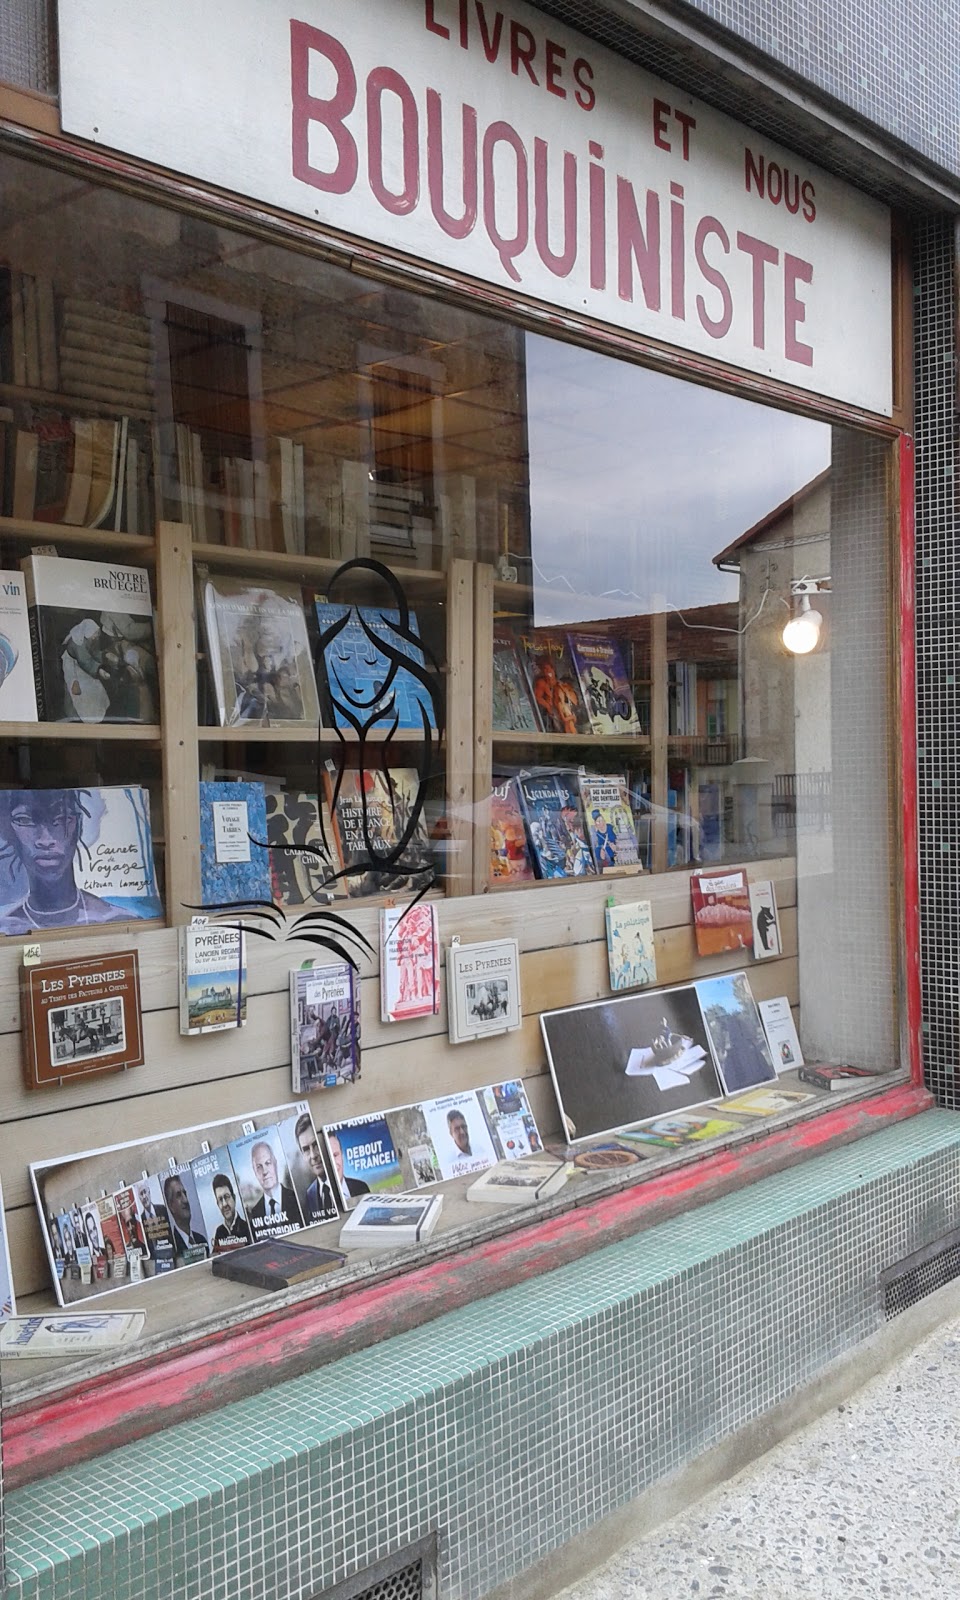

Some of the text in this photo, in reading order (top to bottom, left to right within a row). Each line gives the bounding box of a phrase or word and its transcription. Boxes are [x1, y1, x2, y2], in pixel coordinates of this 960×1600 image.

[425, 0, 816, 223] LIVRES ET NOUS
[109, 570, 147, 583] NOTRE
[2, 581, 21, 596] vin
[94, 578, 148, 594] BRUEGEL
[343, 819, 356, 830] DE
[345, 831, 358, 841] EN
[96, 844, 138, 856] Carnets
[346, 839, 392, 852] TABLAUX
[89, 859, 146, 879] Voyage
[459, 963, 474, 974] LES
[475, 956, 512, 972] PYRENEES
[41, 969, 126, 993] LES PYRENEES
[346, 1140, 383, 1161] DEBOUT
[194, 1161, 219, 1178] PEUPLE
[252, 1211, 288, 1228] UN CHOIX
[312, 1209, 326, 1219] UNE
